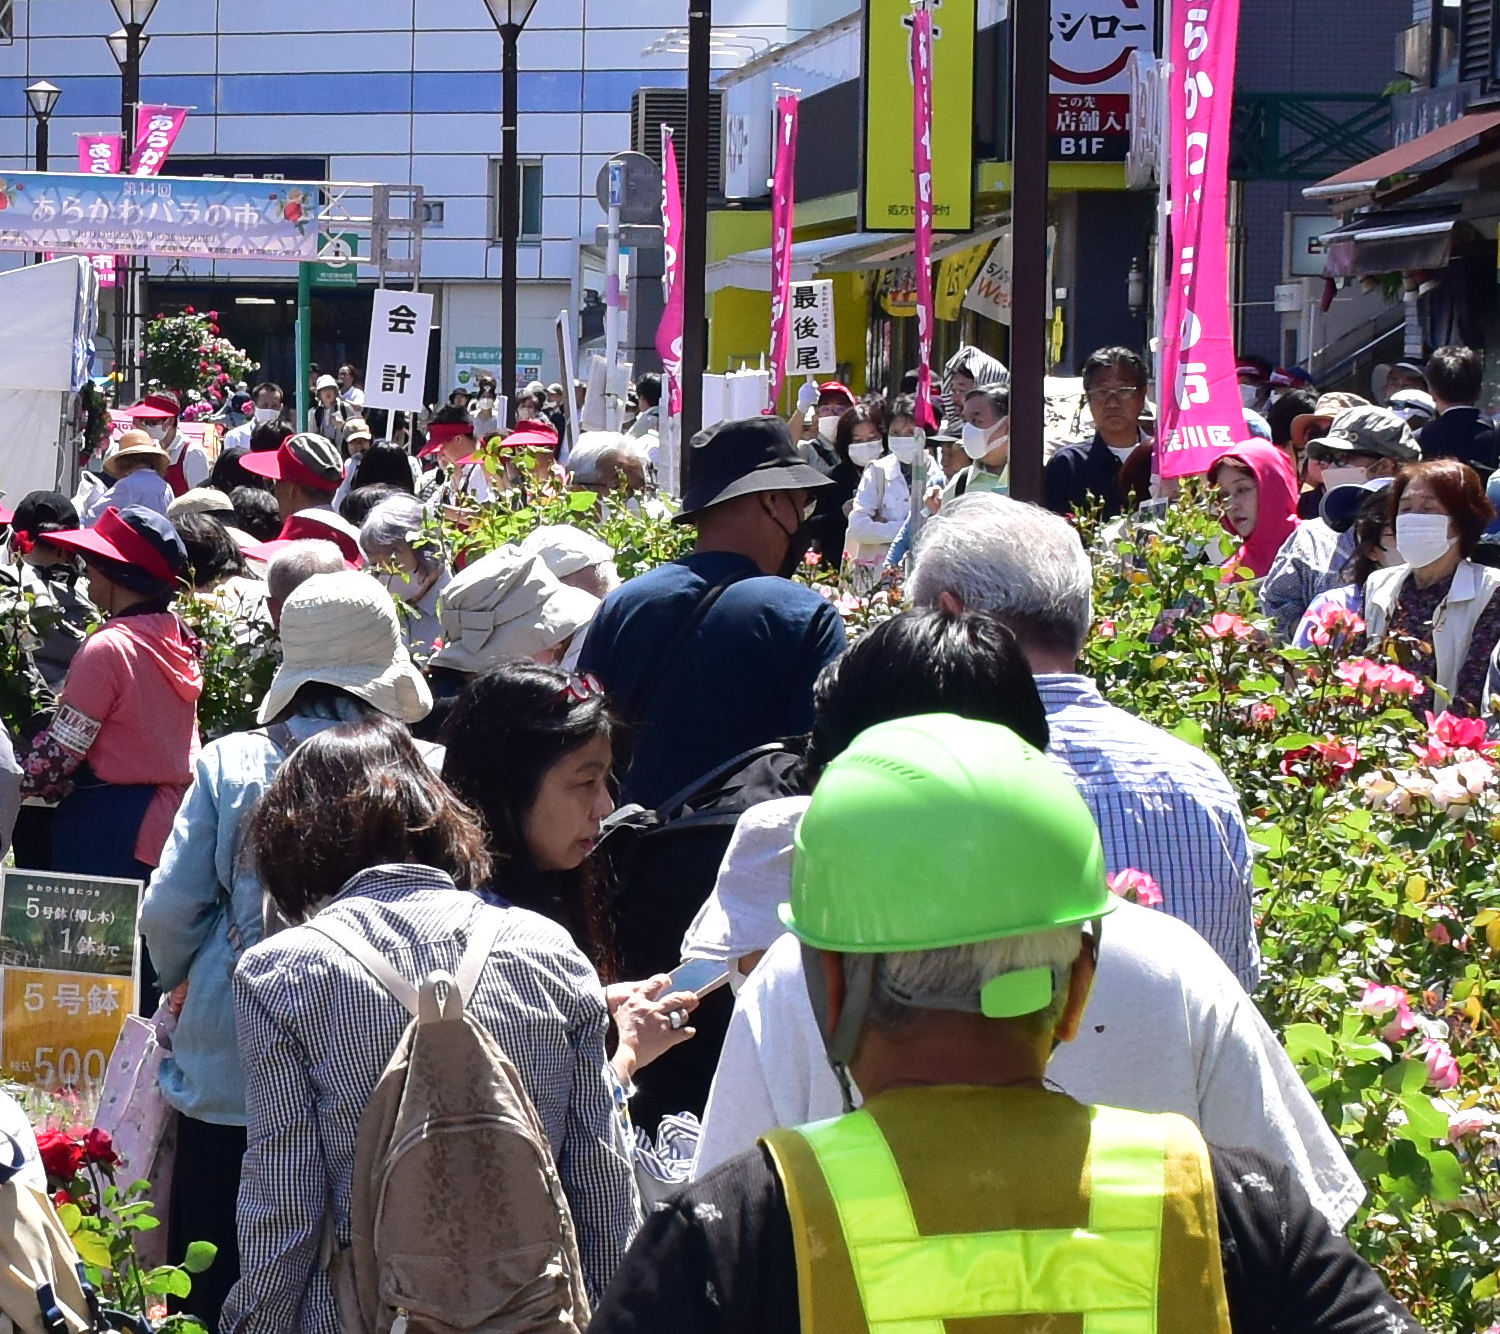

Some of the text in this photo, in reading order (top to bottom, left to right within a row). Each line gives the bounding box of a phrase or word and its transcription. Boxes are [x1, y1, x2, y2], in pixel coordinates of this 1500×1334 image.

[1050, 12, 1147, 42] シロー
[1058, 95, 1097, 109] この先
[1056, 110, 1130, 133] 店舗入
[1060, 137, 1105, 155] B1F
[122, 181, 172, 198] 第14回
[31, 194, 261, 229] あらかわバラの市
[887, 204, 951, 216] 処方せ受付
[792, 285, 821, 370] 最後尾
[381, 304, 418, 395] 会計
[59, 926, 121, 958] 1鉢まで
[23, 981, 121, 1017] 5号鉢
